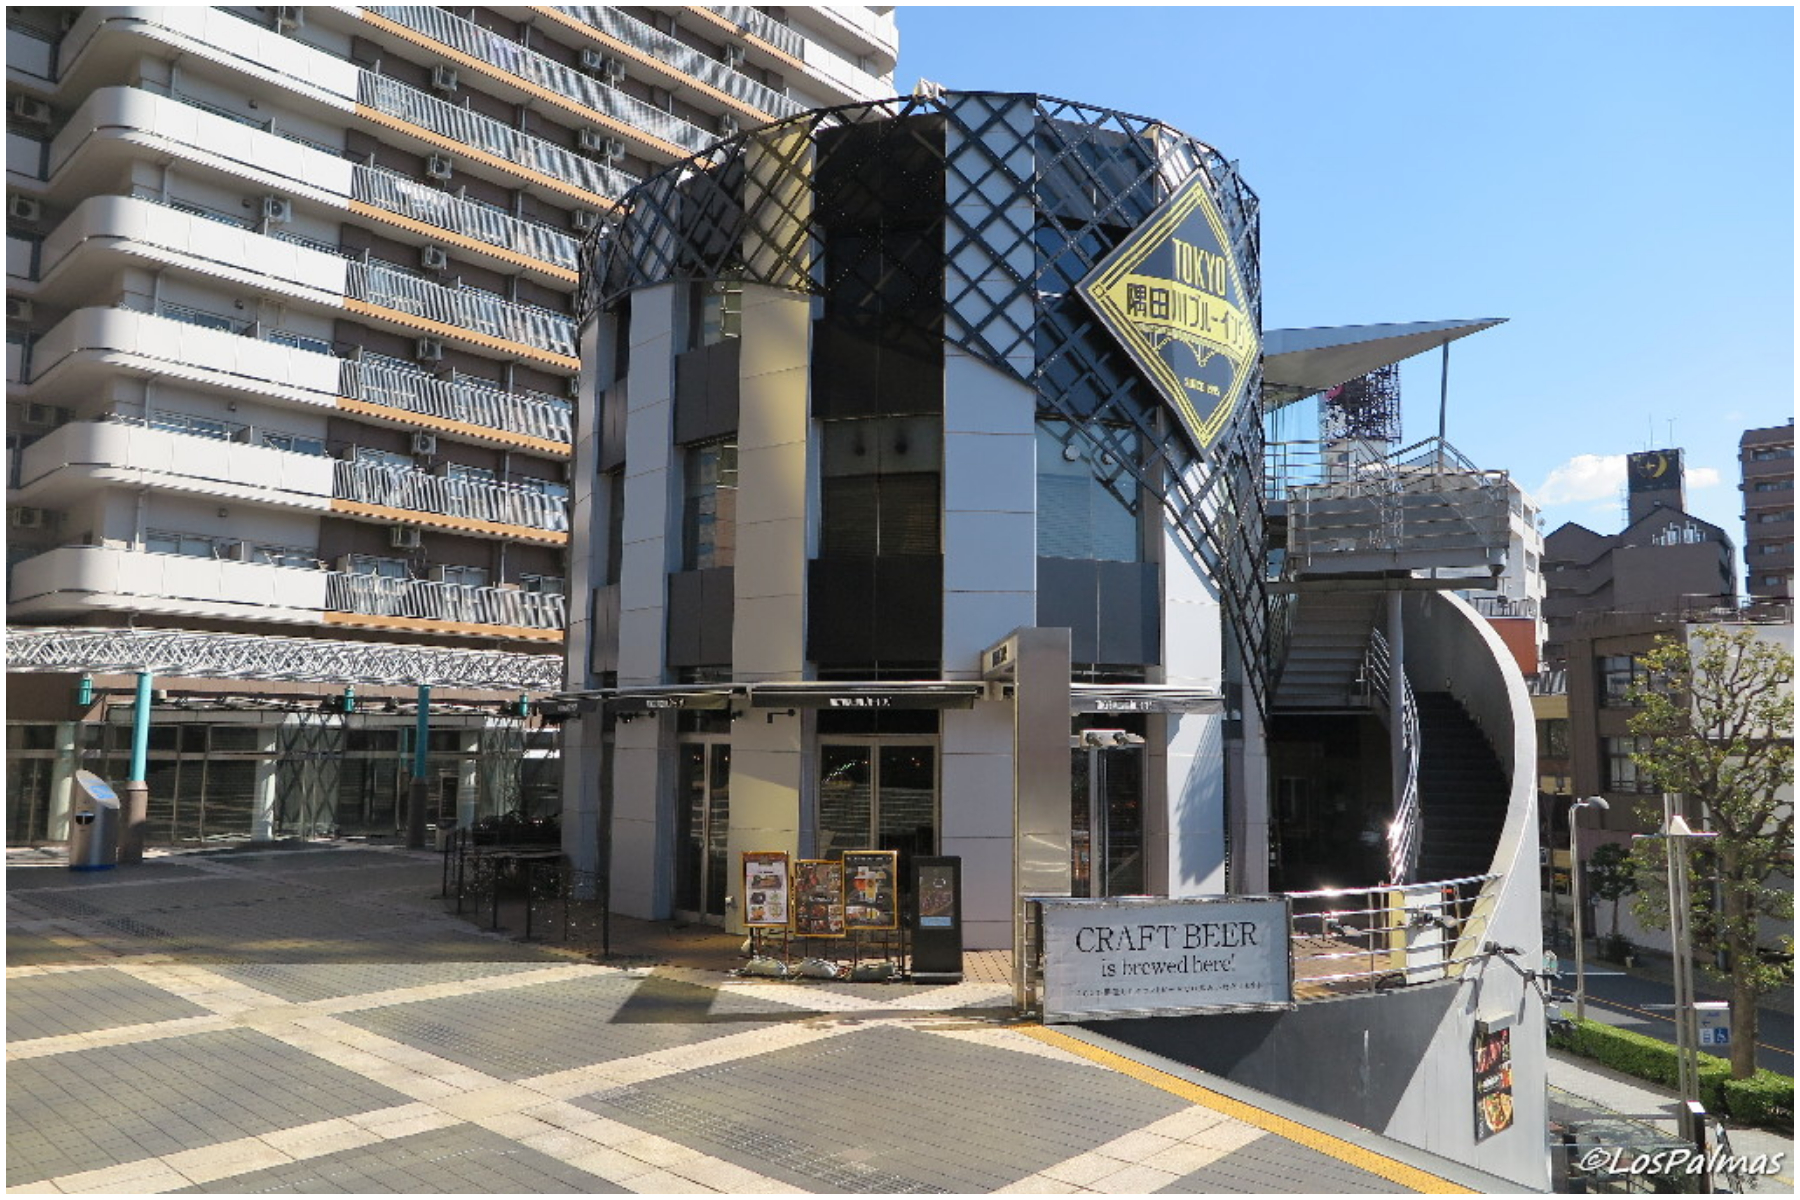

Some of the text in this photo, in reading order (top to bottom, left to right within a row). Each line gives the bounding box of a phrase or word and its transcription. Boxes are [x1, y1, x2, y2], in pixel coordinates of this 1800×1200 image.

[1171, 237, 1227, 297] TOKYO
[1075, 920, 1258, 953] CRAFT BEER
[1101, 958, 1116, 977] is
[1122, 954, 1189, 976] brewed
